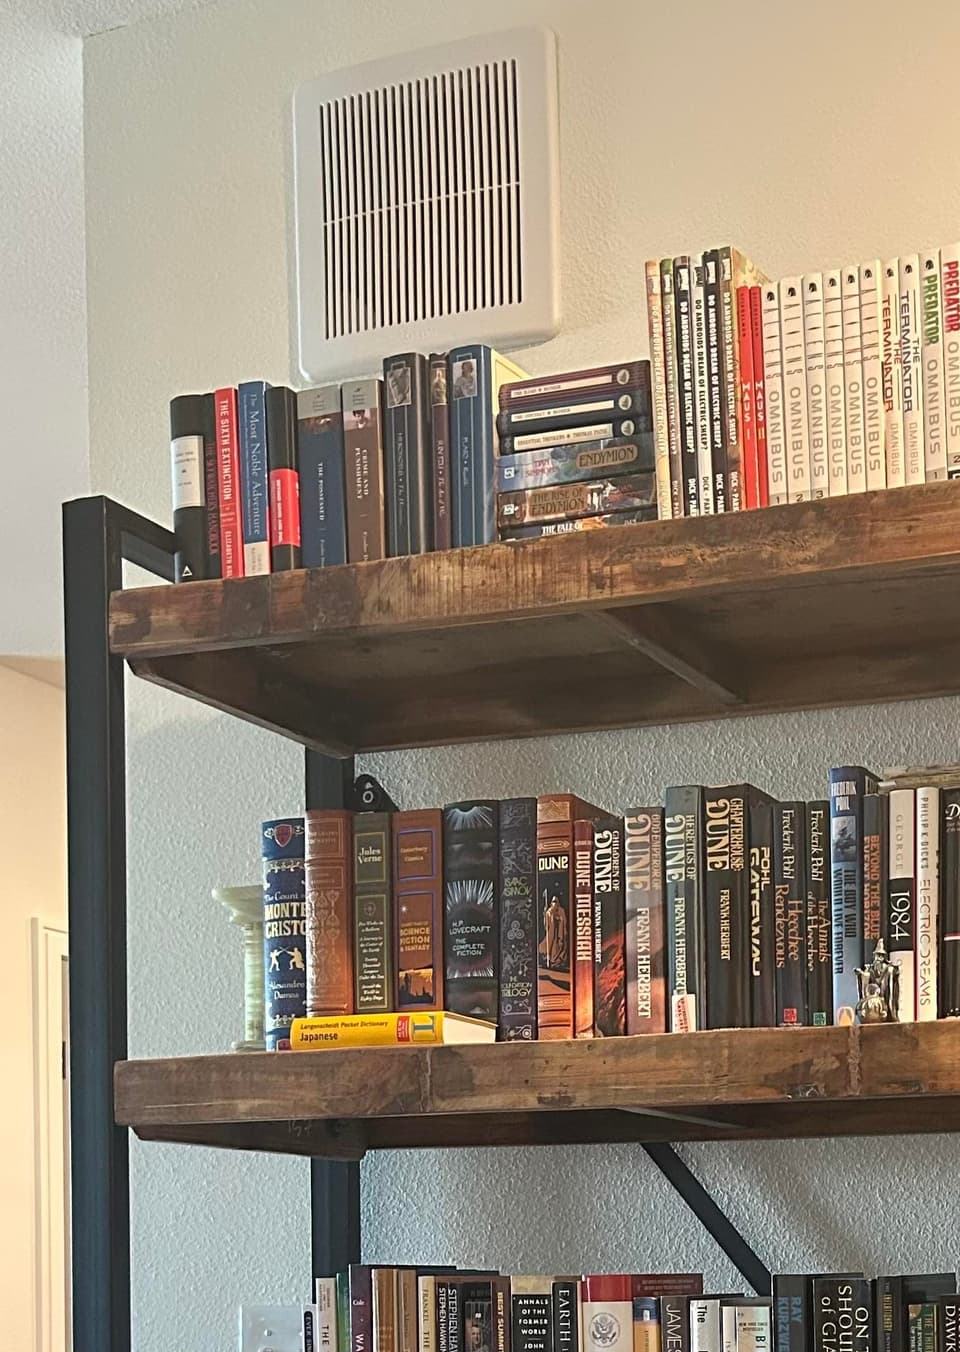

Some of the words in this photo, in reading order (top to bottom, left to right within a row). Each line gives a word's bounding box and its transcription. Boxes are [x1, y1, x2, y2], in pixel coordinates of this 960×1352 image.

[923, 274, 939, 346] PREDATOR
[943, 261, 960, 333] PREDATOR
[220, 399, 230, 418] THE
[742, 383, 751, 423] MAUS
[928, 359, 941, 455] OMNIBUS
[220, 420, 230, 442] SIXTH
[790, 387, 804, 480] OMNIBUS
[811, 383, 824, 477] OMNIBUS
[222, 446, 232, 501] EXTINCTION
[579, 448, 635, 468] ENDYMION
[706, 798, 730, 871] DUNE
[538, 855, 568, 871] DUNE
[576, 851, 590, 888] DUNE
[761, 846, 770, 891] POHL
[450, 926, 490, 935] LOVECRAFT
[576, 894, 591, 960] MESSIAH
[788, 900, 803, 960] Heechee
[890, 891, 910, 941] 1984
[920, 880, 931, 943] ELECTRIC
[920, 946, 931, 1006] DREAMS
[300, 1032, 338, 1042] Japanese
[559, 1290, 572, 1342] EARTH
[856, 1307, 869, 1339] ON
